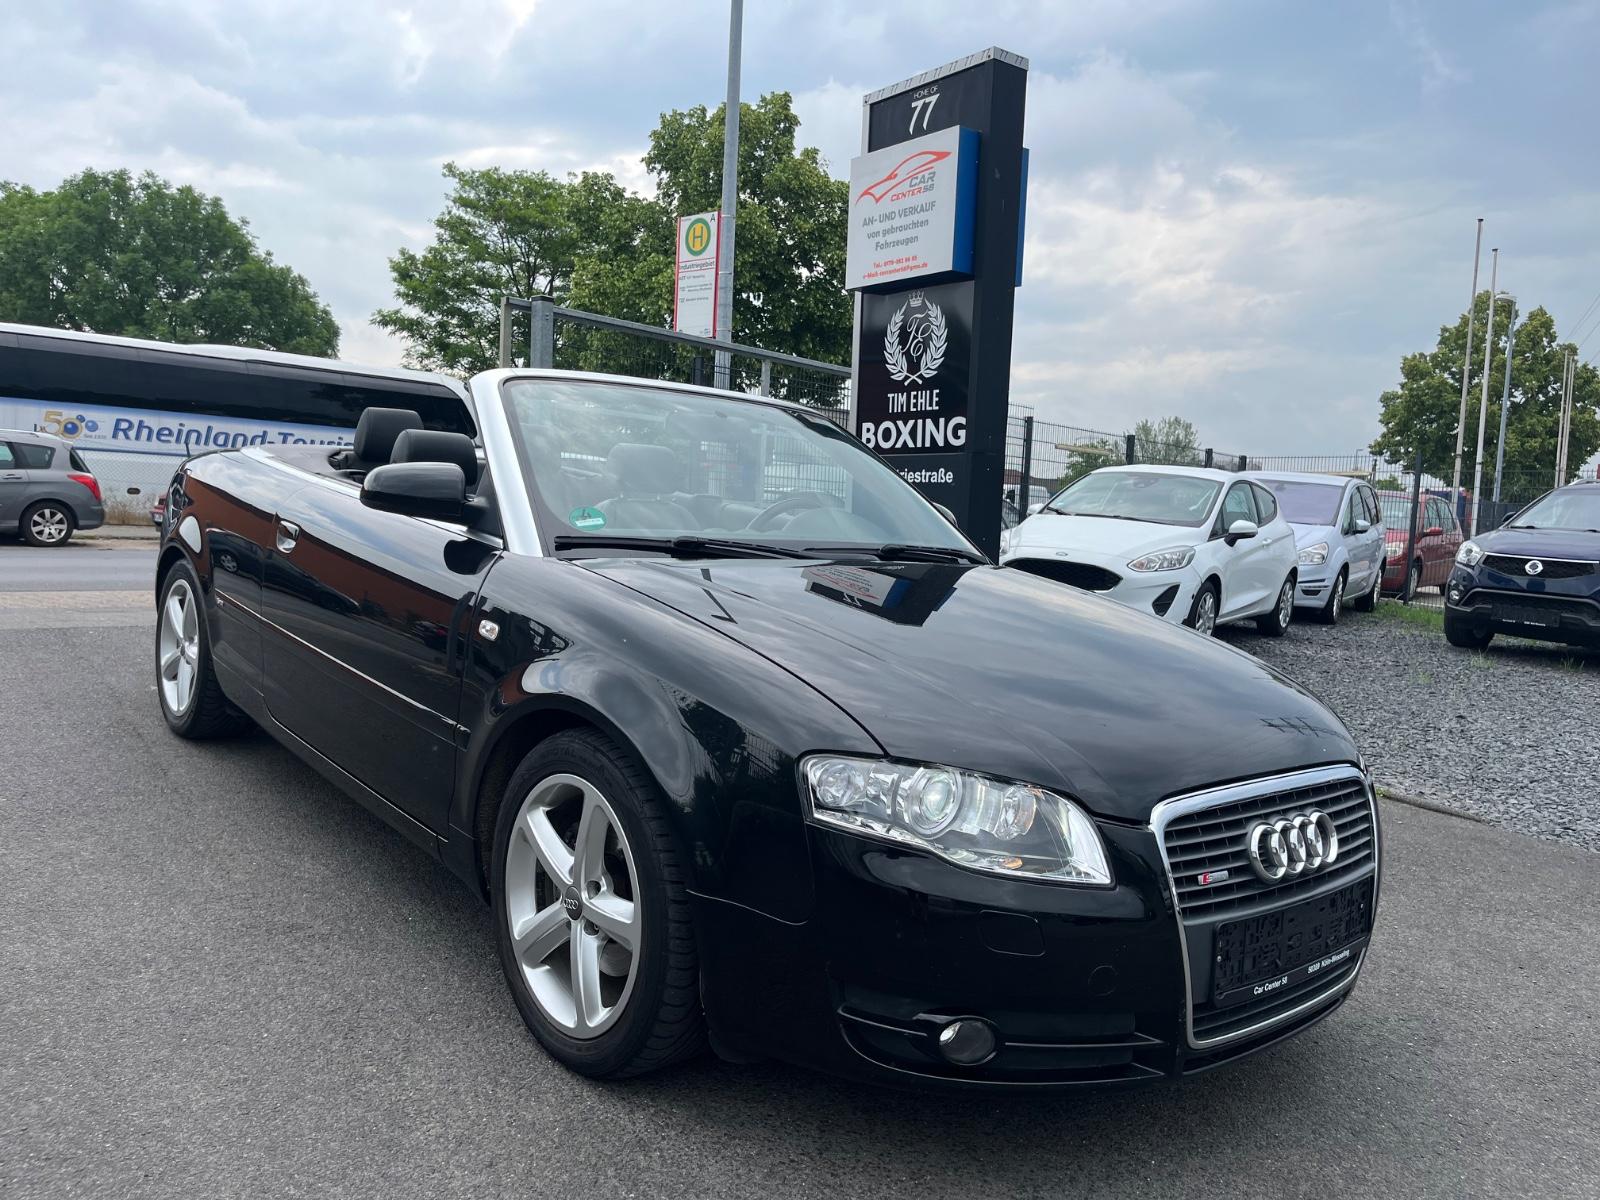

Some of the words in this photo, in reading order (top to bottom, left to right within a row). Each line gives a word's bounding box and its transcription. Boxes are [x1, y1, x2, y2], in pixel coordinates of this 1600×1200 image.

[913, 88, 929, 99] HOME
[930, 84, 939, 94] OF
[909, 93, 940, 135] 77
[909, 171, 936, 188] CAR
[710, 213, 716, 223] A
[862, 216, 878, 228] AN-
[879, 211, 896, 223] UND
[898, 201, 936, 219] VERKAUF
[867, 230, 880, 240] von
[882, 219, 929, 238] gebrauchten
[875, 235, 919, 251] Fahrzeugen
[888, 392, 907, 413] TIM
[910, 389, 940, 412] EHLE
[861, 416, 967, 449] BOXING
[1253, 986, 1264, 995] Car
[1264, 979, 1281, 991] Center
